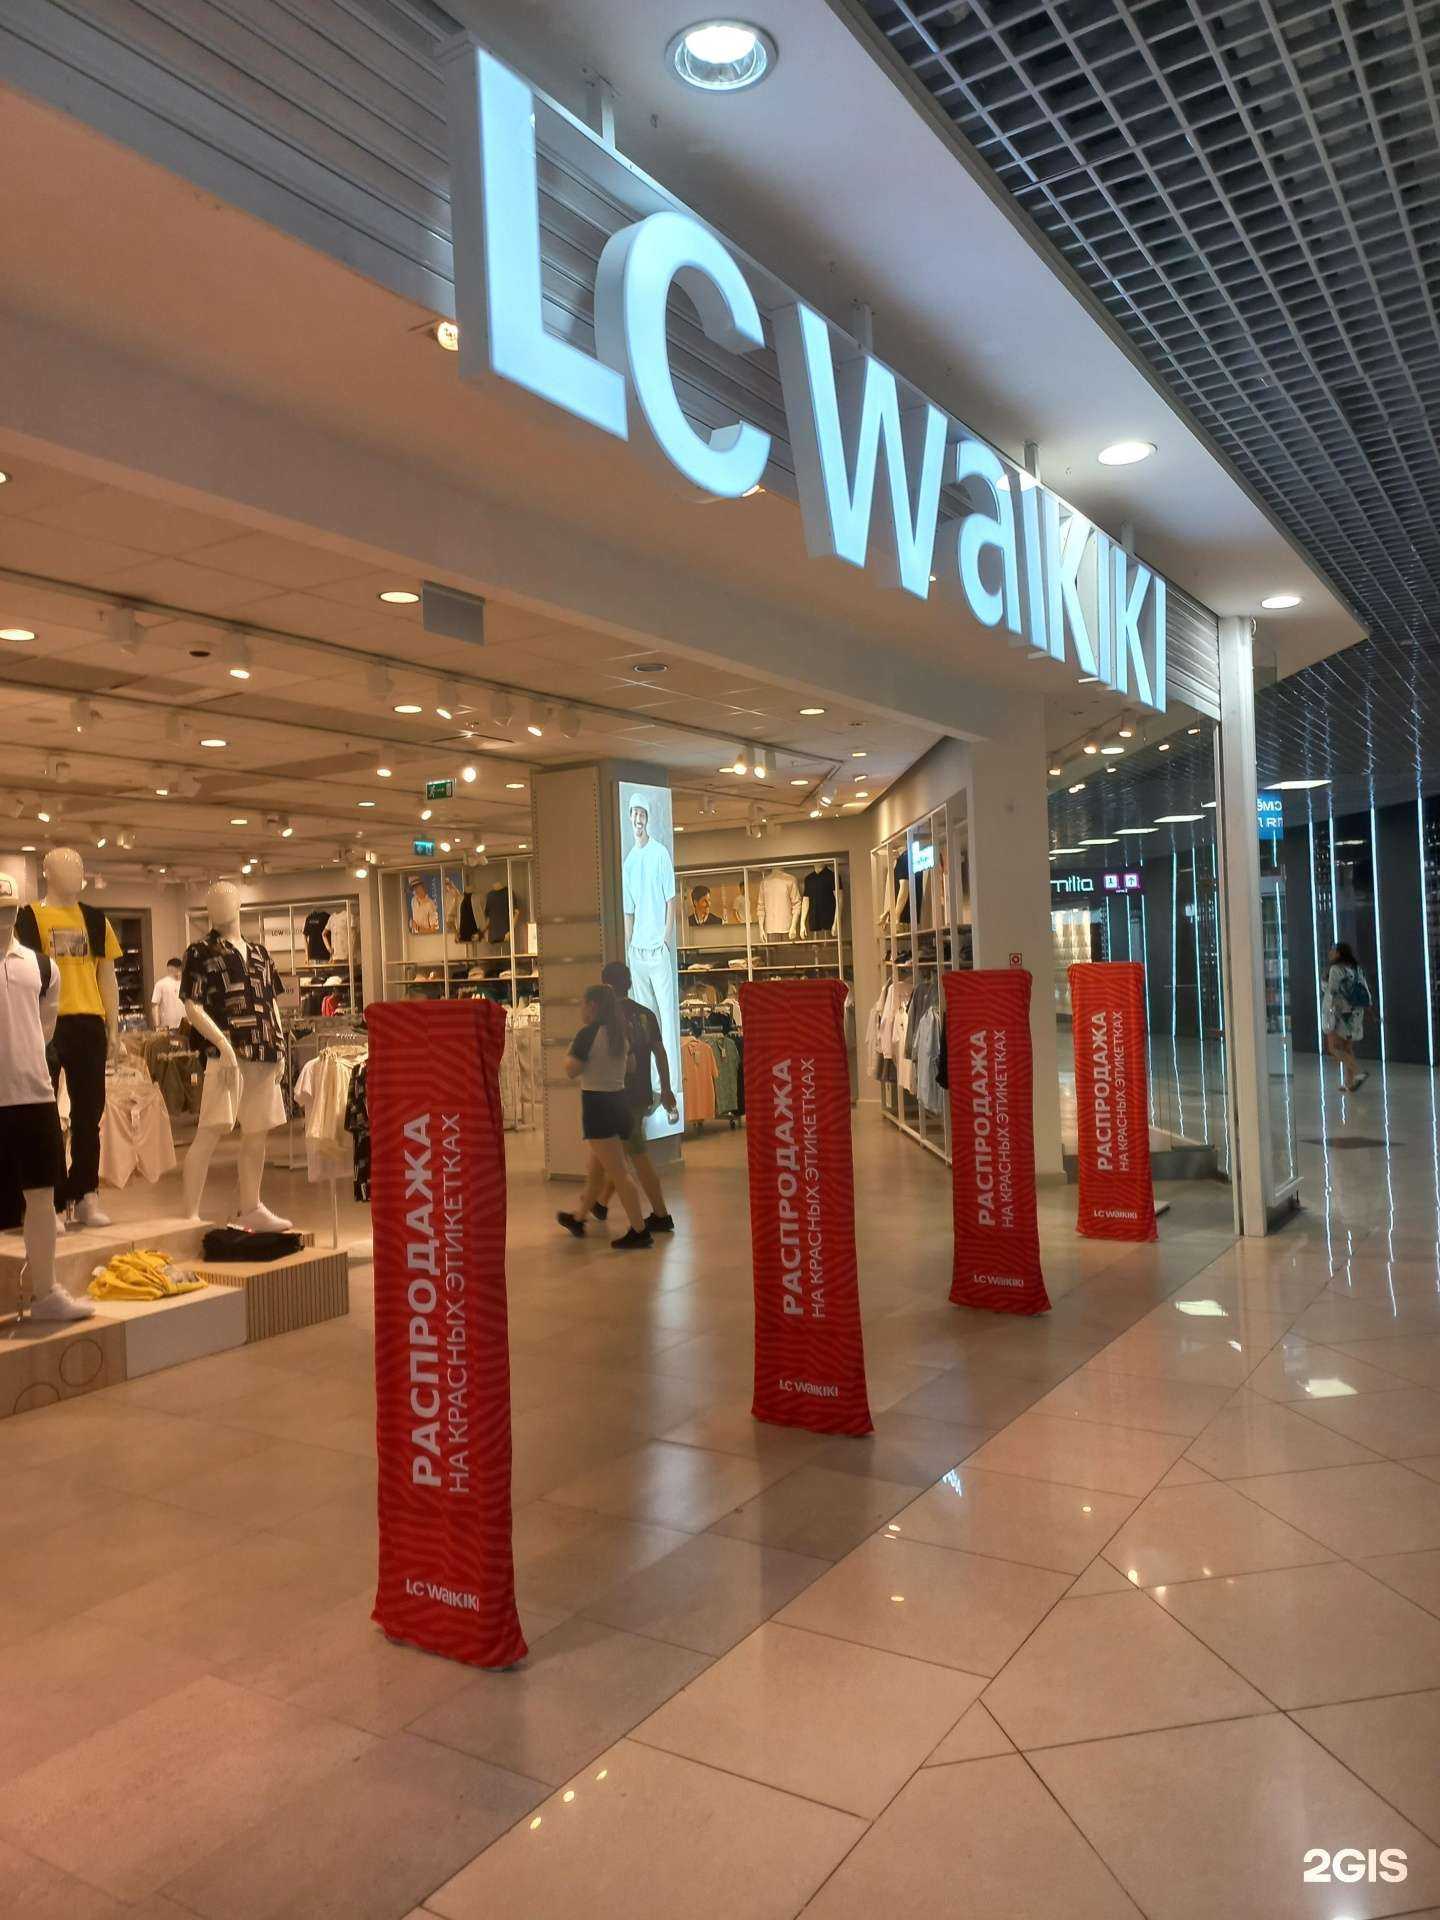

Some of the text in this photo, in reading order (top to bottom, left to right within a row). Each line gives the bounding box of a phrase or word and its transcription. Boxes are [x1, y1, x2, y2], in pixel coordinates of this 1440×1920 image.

[474, 46, 772, 499] LC
[772, 1058, 804, 1316] РАСПРОДАЖА
[800, 1057, 826, 1319] НА КРАСНЫХ ЭТИКЕТКАХ
[970, 1029, 996, 1226] РАСПРОДАЖА
[993, 1029, 1014, 1228] НА КРАСНЫХ ЭТИКЕТКАХ
[1091, 1011, 1113, 1171] РАСПРОДАЖА
[1112, 1010, 1130, 1172] НА КРАСНЫХ ЭТИКЕТКАХ
[403, 1113, 442, 1487] РАСПРОДАЖА
[441, 1112, 470, 1494] НА КРАСНЫХ ЭТИКЕТКАХ
[974, 1274, 986, 1284] LC
[779, 1379, 794, 1393] LC
[405, 1578, 426, 1597] LC
